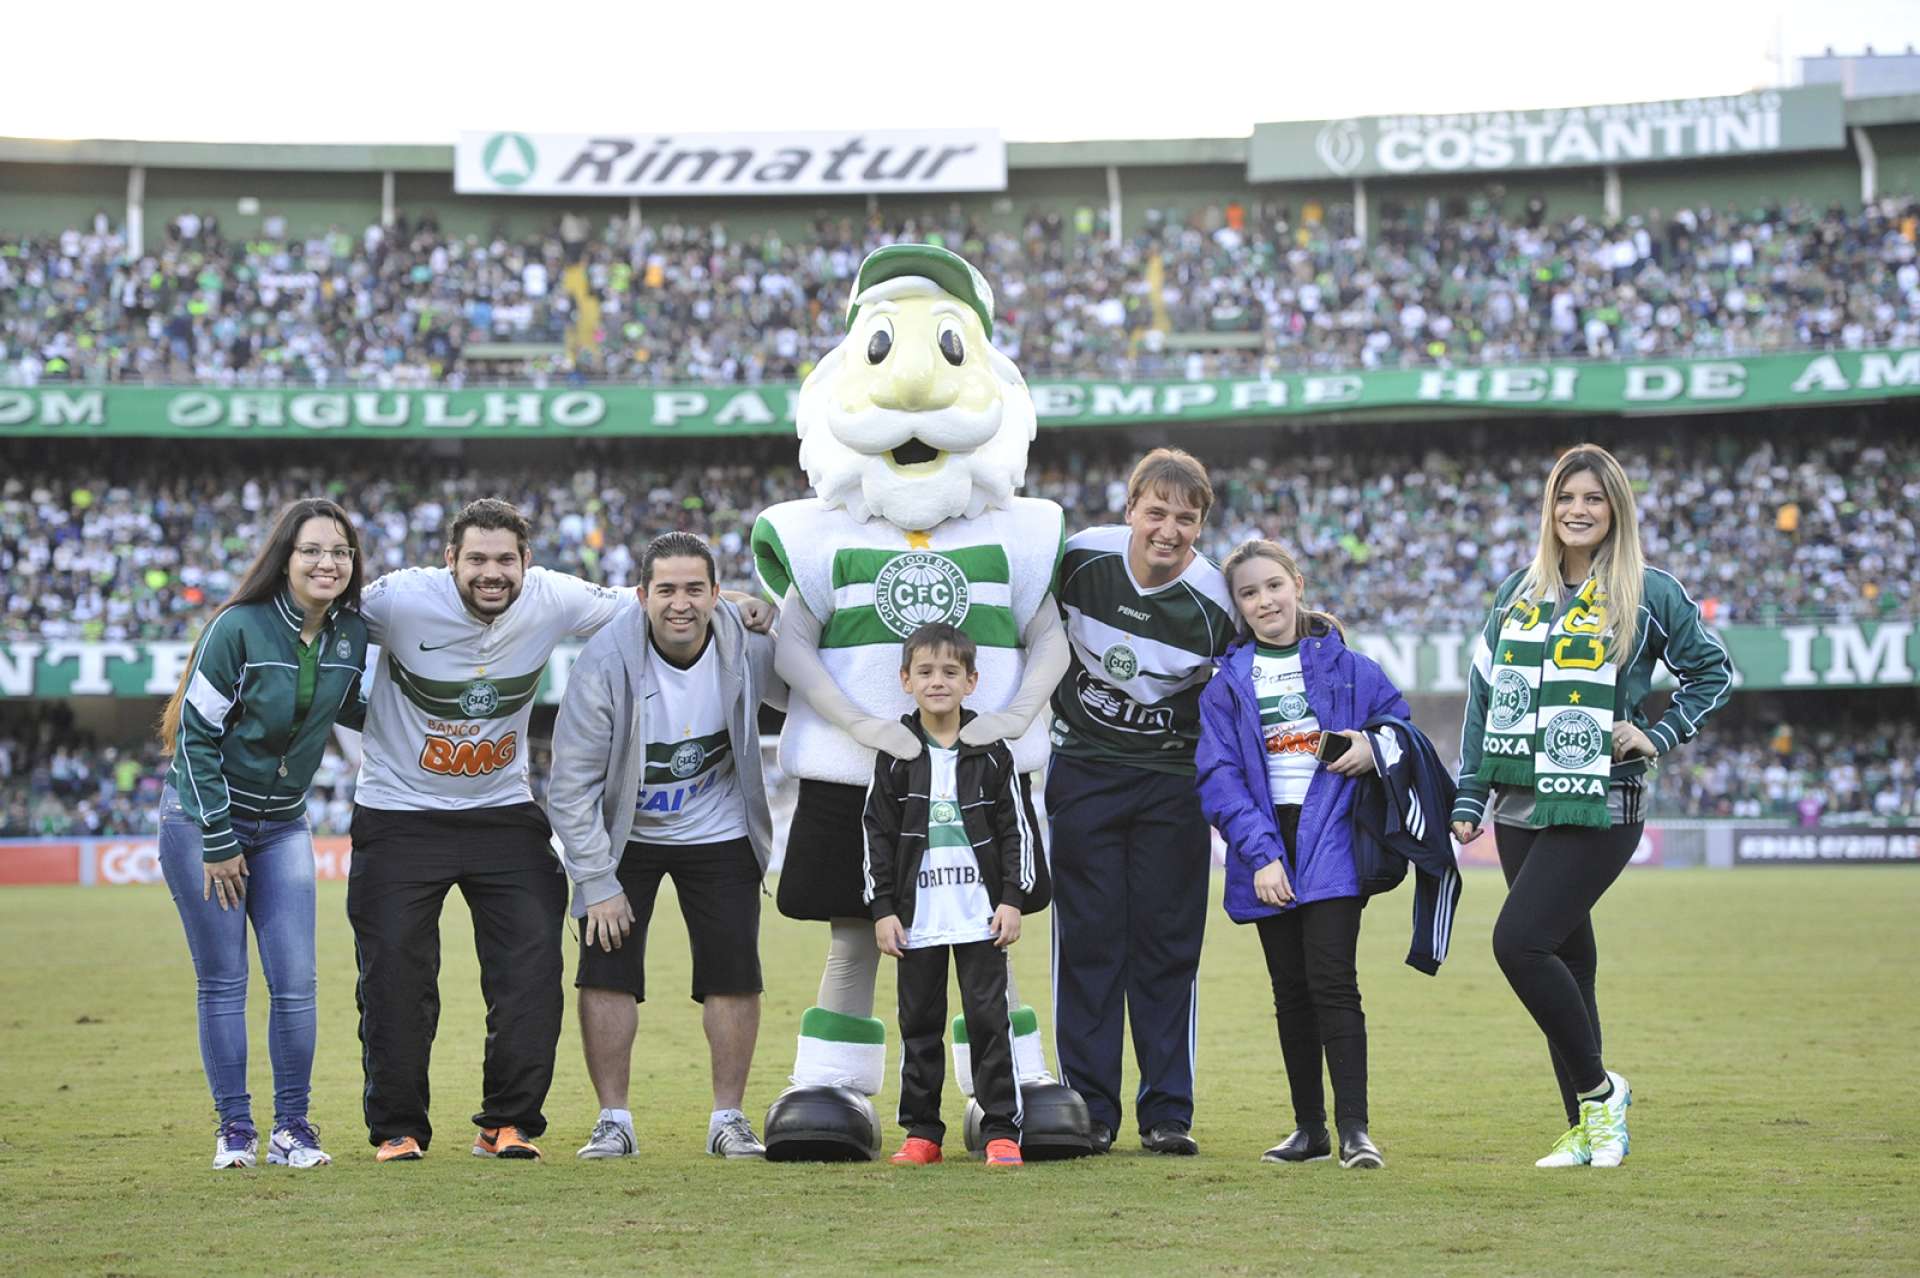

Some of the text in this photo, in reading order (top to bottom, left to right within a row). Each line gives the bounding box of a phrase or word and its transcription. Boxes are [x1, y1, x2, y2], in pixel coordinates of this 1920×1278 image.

[1376, 111, 1782, 173] COSTANTINI
[557, 138, 978, 185] Rimatur
[166, 390, 606, 428] ORGULHO
[1417, 365, 1580, 401] HEI
[1622, 361, 1748, 400] DE
[876, 556, 969, 621] CORITIBA FOOT BALL CLUB
[894, 584, 950, 606] CFC
[1117, 605, 1152, 622] PENALTY
[427, 719, 480, 737] BANCO
[1556, 731, 1588, 746] CFC
[419, 731, 517, 777] BMG
[1482, 737, 1531, 755] COXA
[1537, 777, 1605, 796] COXA
